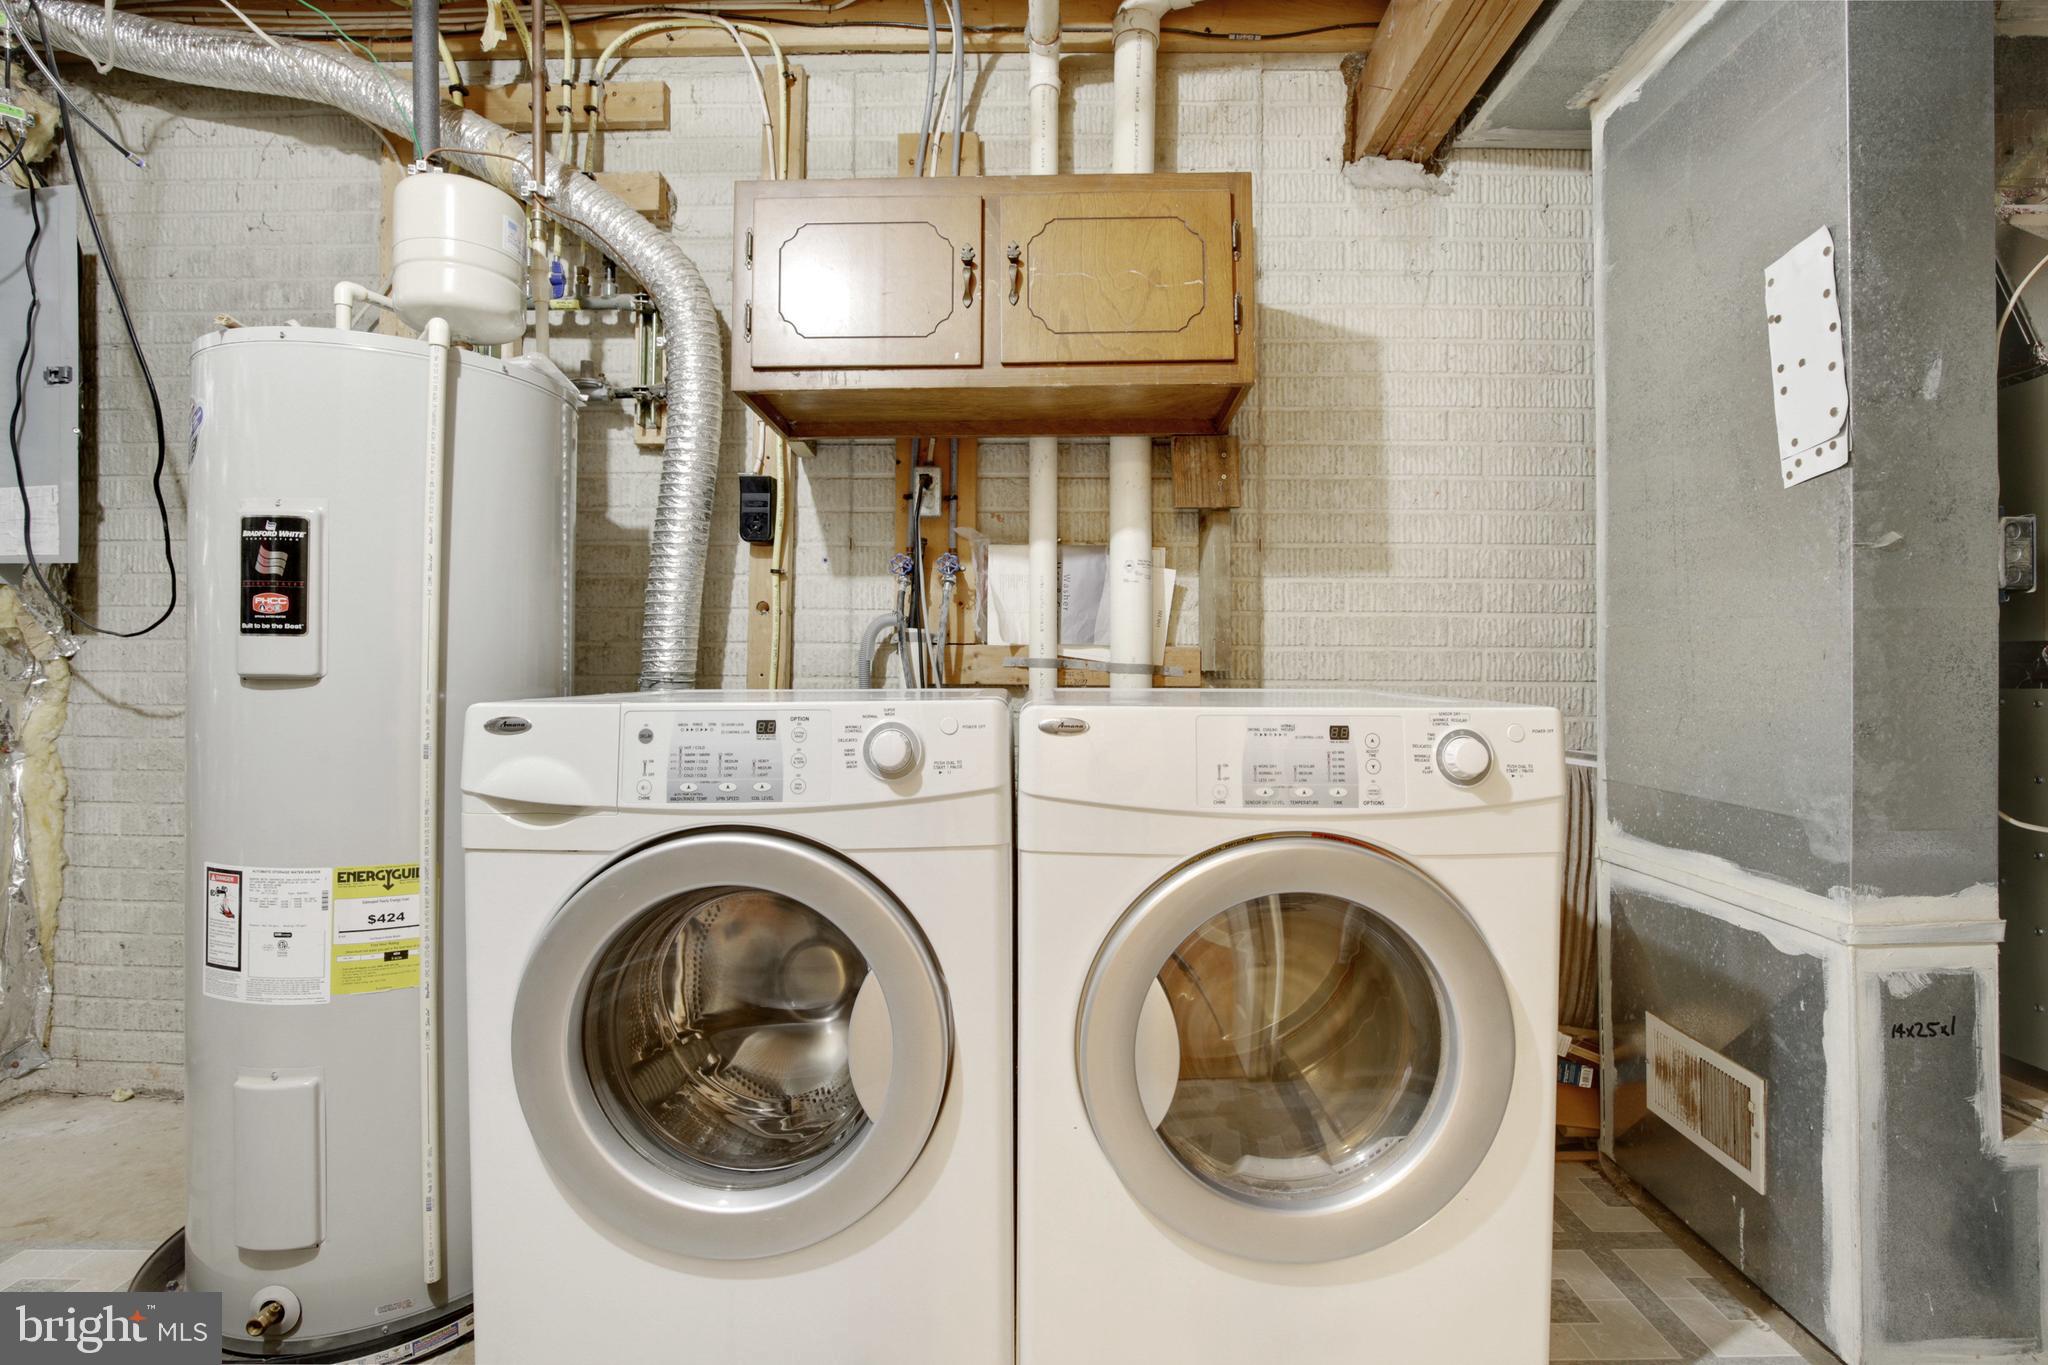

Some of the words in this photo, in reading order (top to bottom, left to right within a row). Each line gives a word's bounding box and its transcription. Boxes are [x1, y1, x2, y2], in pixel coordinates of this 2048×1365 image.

[242, 530, 278, 538] BRADFORD
[278, 530, 306, 538] WHITE
[1063, 573, 1071, 612] Washer
[368, 912, 406, 925] $424
